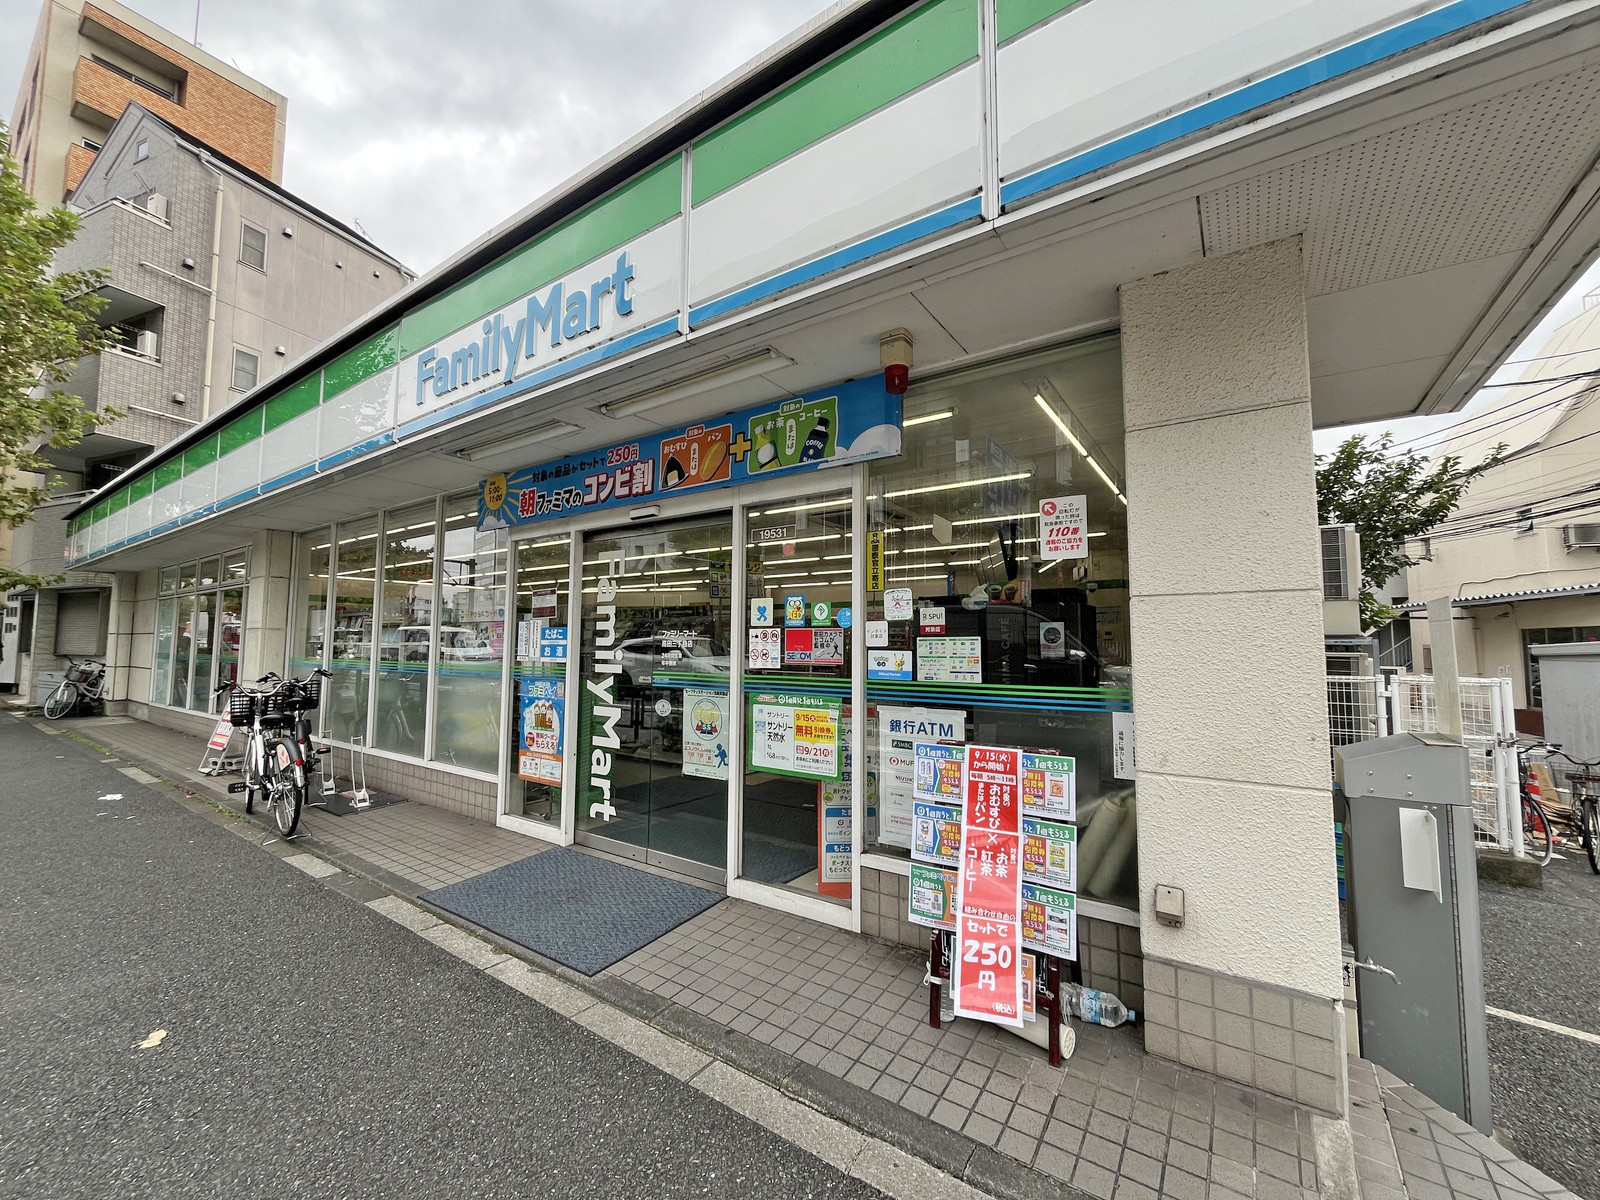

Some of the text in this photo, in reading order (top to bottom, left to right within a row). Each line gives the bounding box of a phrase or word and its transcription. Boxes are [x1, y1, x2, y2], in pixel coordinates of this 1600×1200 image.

[416, 250, 634, 405] FamilyMart
[799, 409, 828, 420] コーヒー
[766, 416, 785, 430] お茶
[707, 432, 722, 442] パン
[663, 441, 688, 454] おむすび
[805, 439, 824, 449] COFFEE
[759, 528, 787, 540] 19531
[1048, 526, 1081, 538] 110番
[1048, 544, 1081, 552] お願いします
[544, 628, 563, 639] たばこ
[661, 629, 698, 639] ファミリーマート
[543, 646, 563, 657] お酒
[786, 651, 812, 661] SECOM
[528, 685, 557, 698] ファミペイ
[587, 549, 625, 822] FamilyMart
[767, 711, 790, 719] サントリー
[767, 721, 794, 732] サントリー
[795, 724, 814, 738] 無料
[889, 718, 954, 738] 銀行ATM
[767, 731, 786, 743] 天然水
[897, 741, 913, 750] SMBC
[974, 750, 1012, 763] 9/15(火)
[1002, 784, 1011, 807] 対象の
[988, 783, 1001, 830] おむすび
[964, 905, 1016, 922] 組み合わせ自由の
[966, 919, 1009, 937] セットで
[963, 939, 1012, 969] 250
[978, 970, 996, 992] 円
[992, 1002, 1015, 1015] (税込)
